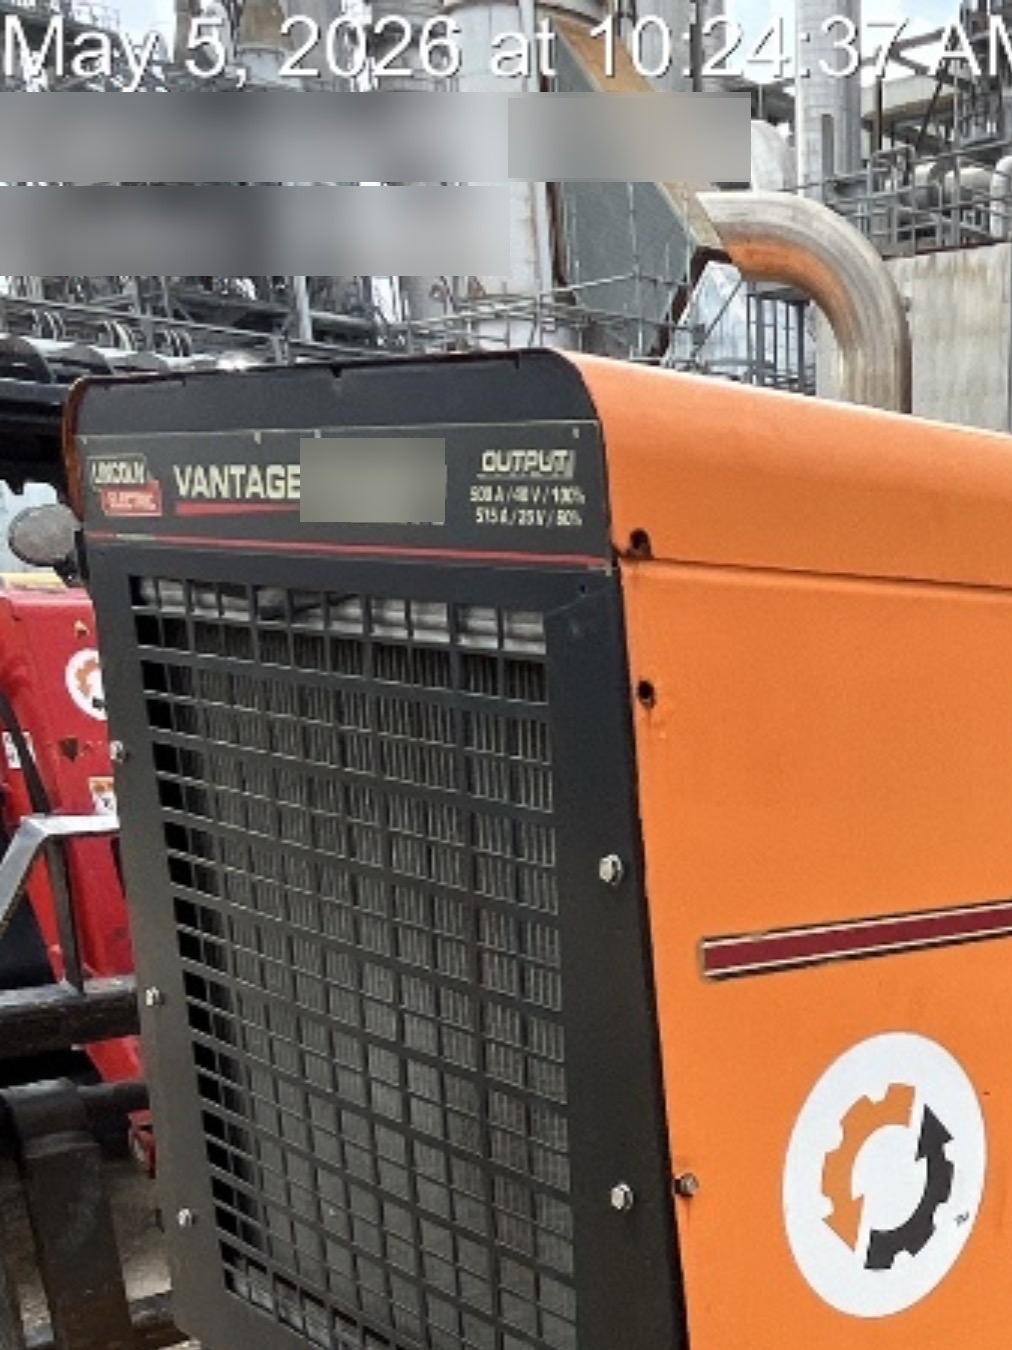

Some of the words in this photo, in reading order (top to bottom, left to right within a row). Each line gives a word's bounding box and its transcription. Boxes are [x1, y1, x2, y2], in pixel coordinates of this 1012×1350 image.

[92, 461, 145, 484] LINCOLN
[481, 449, 570, 473] OUTPUT
[173, 463, 300, 499] VANTAGE
